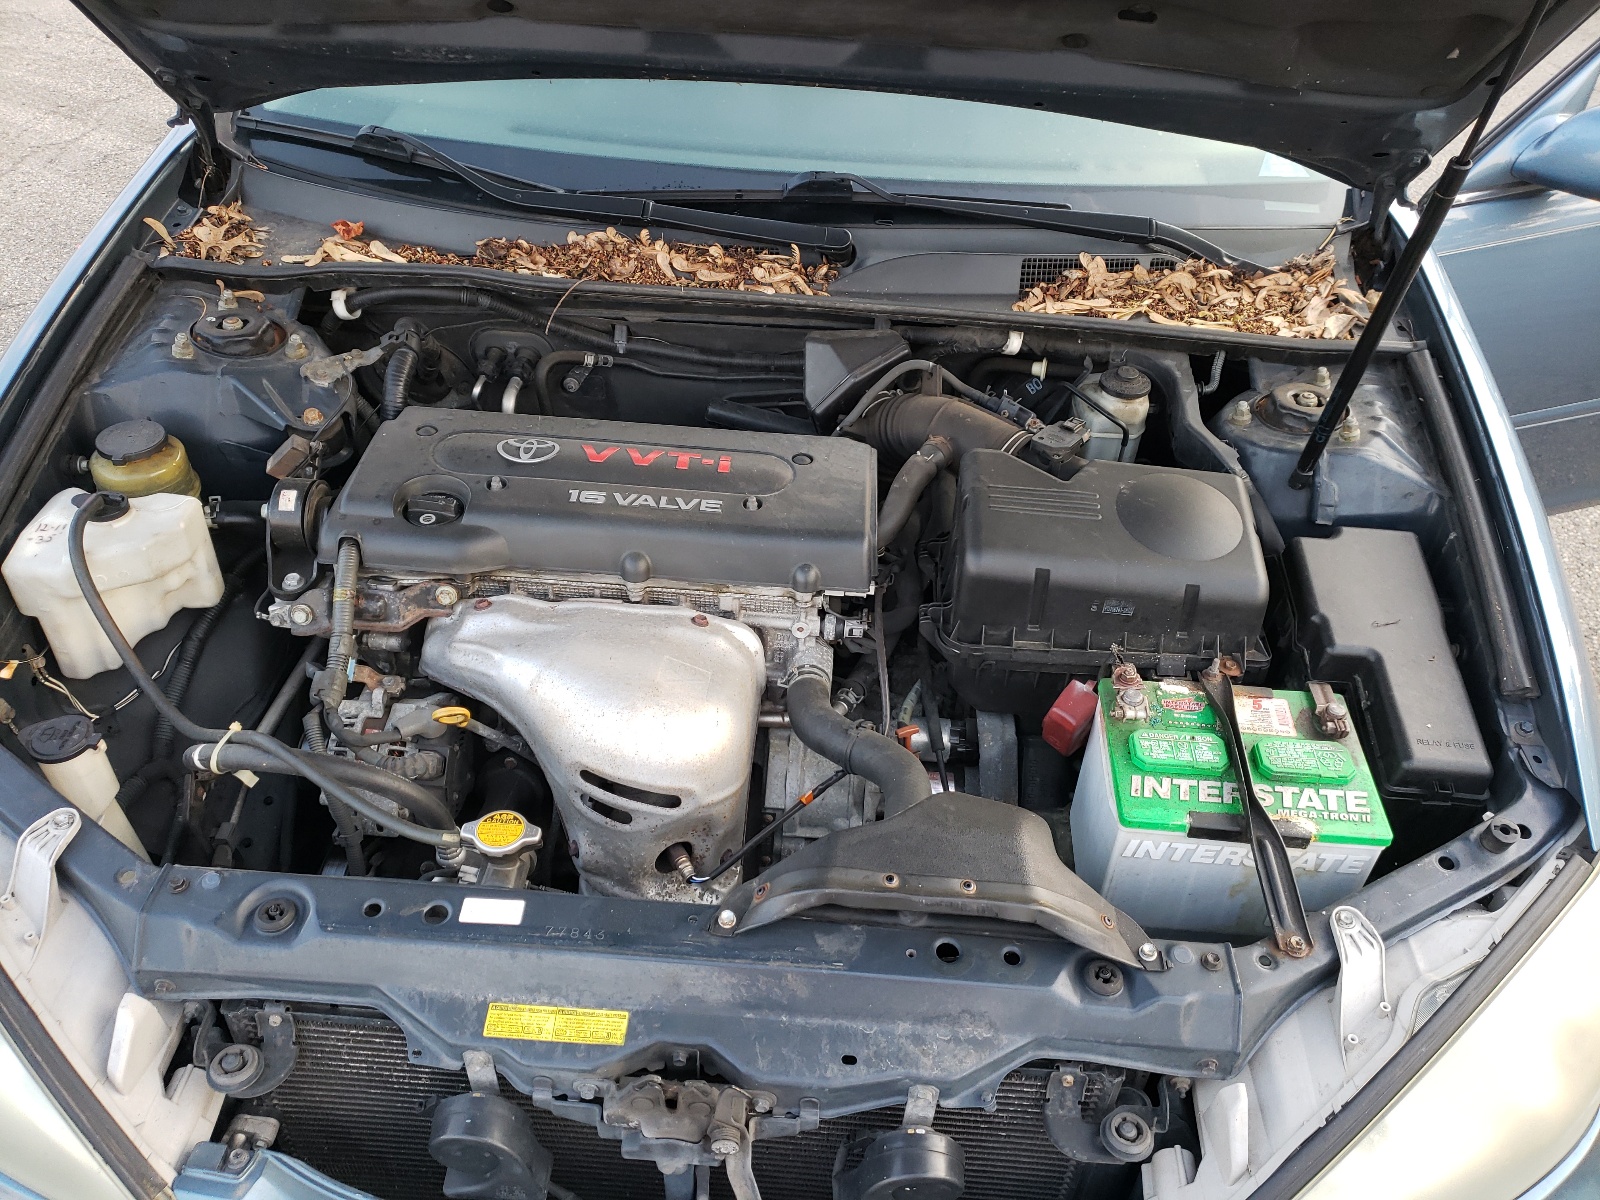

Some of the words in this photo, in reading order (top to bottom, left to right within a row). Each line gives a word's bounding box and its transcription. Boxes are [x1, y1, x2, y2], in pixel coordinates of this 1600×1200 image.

[581, 444, 732, 473] VVT-i
[569, 490, 606, 505] 16
[613, 492, 723, 514] VALVE
[1416, 738, 1442, 747] RELAY
[1453, 741, 1475, 750] FUSE
